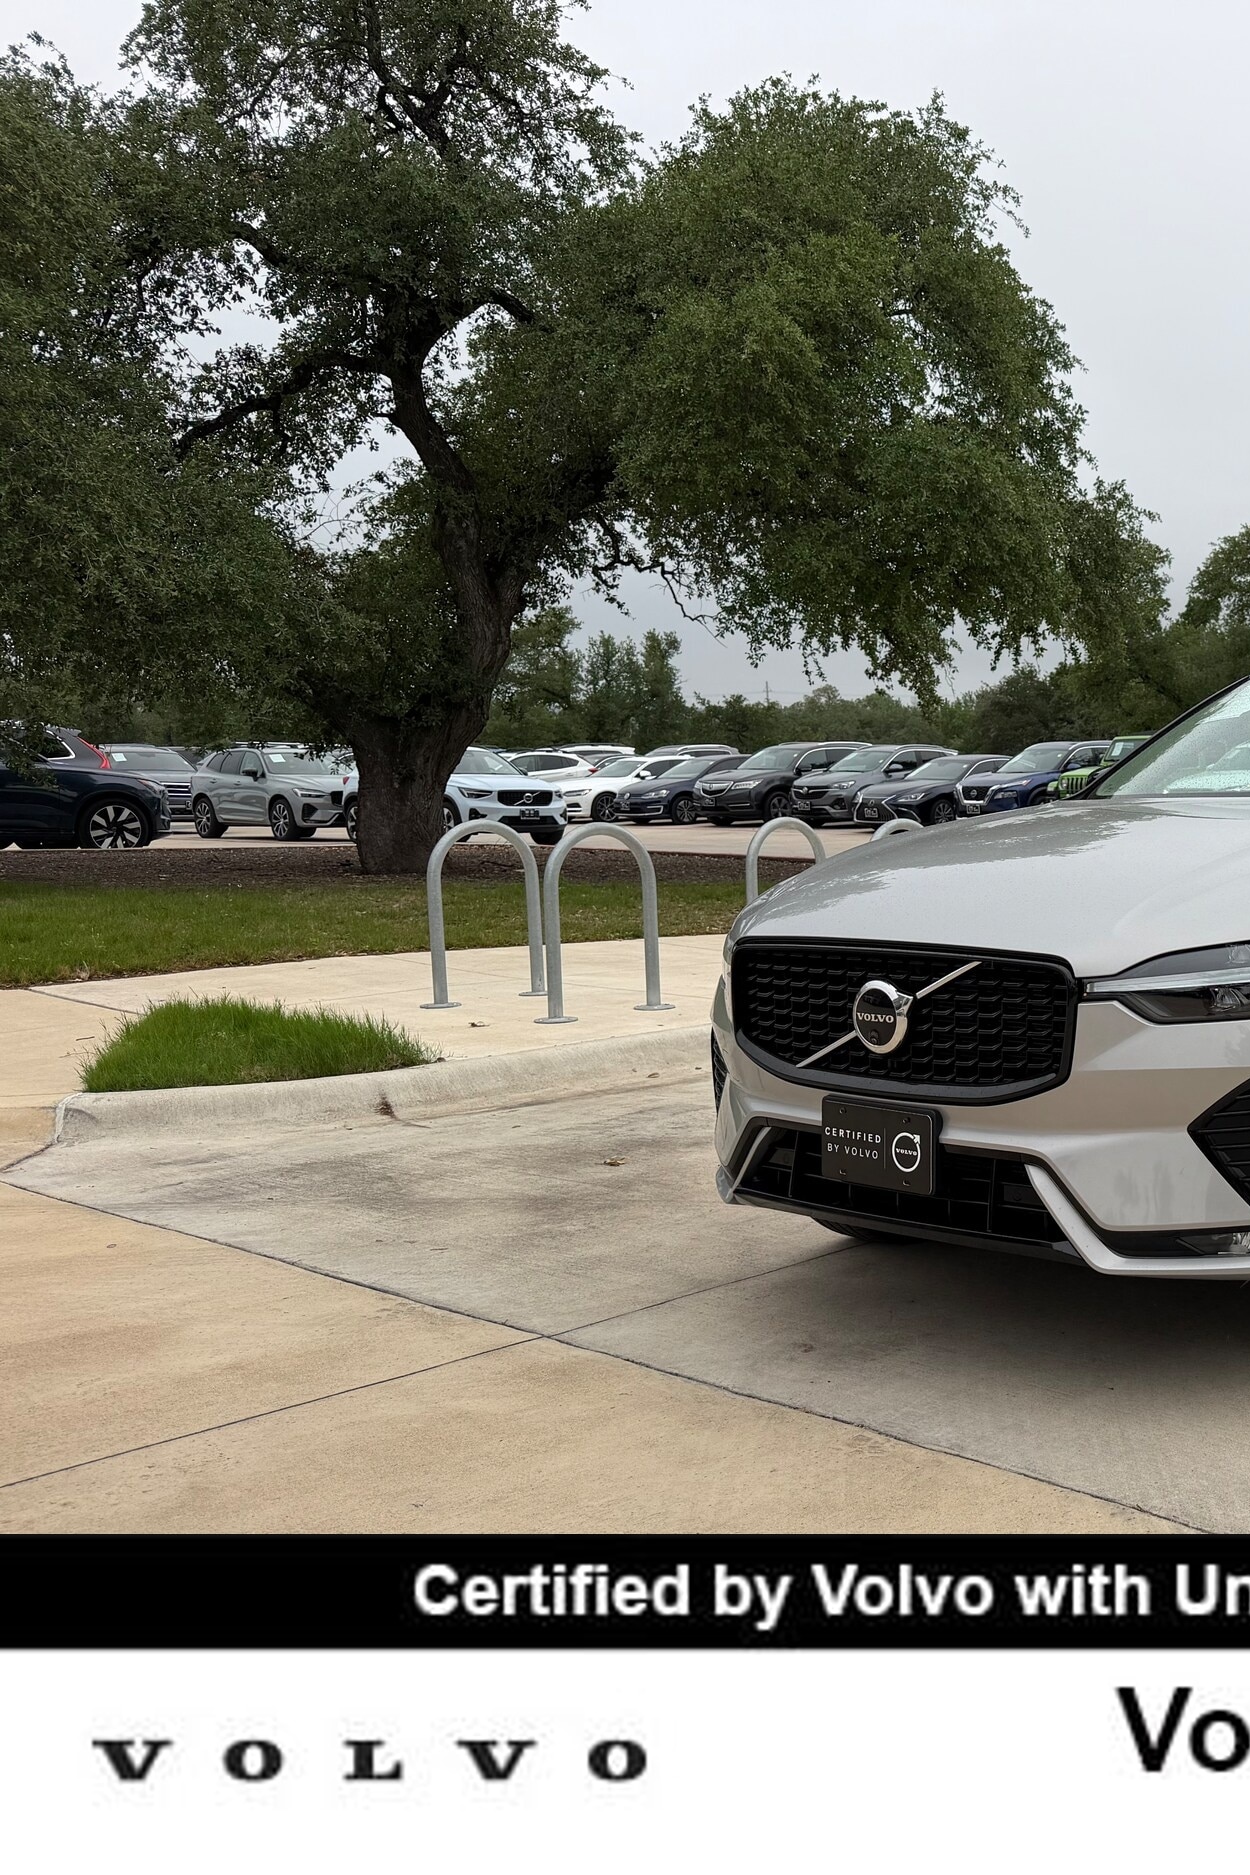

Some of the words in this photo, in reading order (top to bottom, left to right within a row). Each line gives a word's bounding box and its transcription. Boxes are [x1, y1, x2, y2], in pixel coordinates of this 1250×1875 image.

[856, 1012, 894, 1023] VOLVO
[824, 1126, 882, 1144] CERTIFIED
[827, 1143, 840, 1153] BY
[844, 1146, 879, 1160] VOLVO
[895, 1147, 918, 1156] VOLVO
